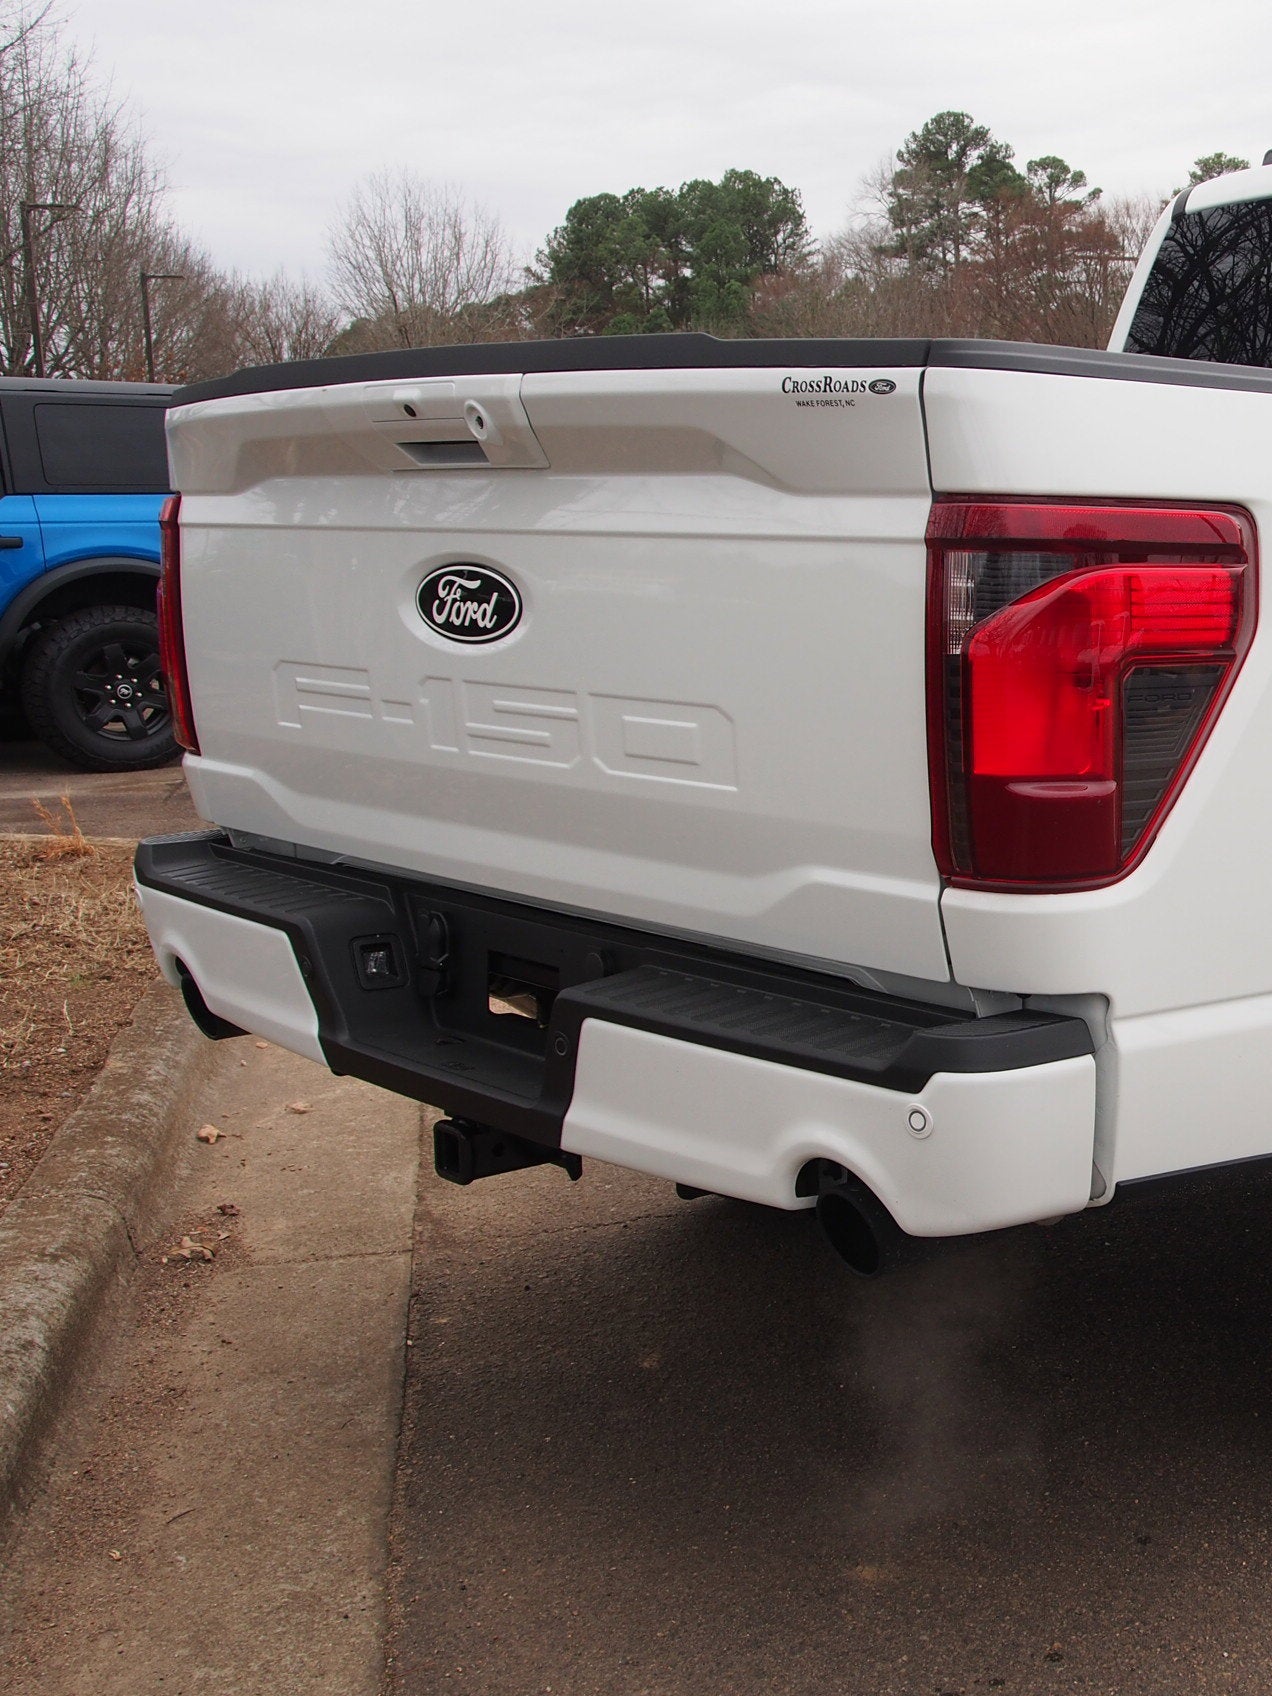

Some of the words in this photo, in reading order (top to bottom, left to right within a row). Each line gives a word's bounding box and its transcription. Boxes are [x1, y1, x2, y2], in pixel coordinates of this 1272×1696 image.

[795, 399, 815, 407] WAKE
[816, 399, 844, 408] FOREST,
[845, 399, 856, 407] NC
[430, 574, 500, 630] Ford
[1128, 692, 1192, 703] FORD
[271, 659, 738, 792] F-150
